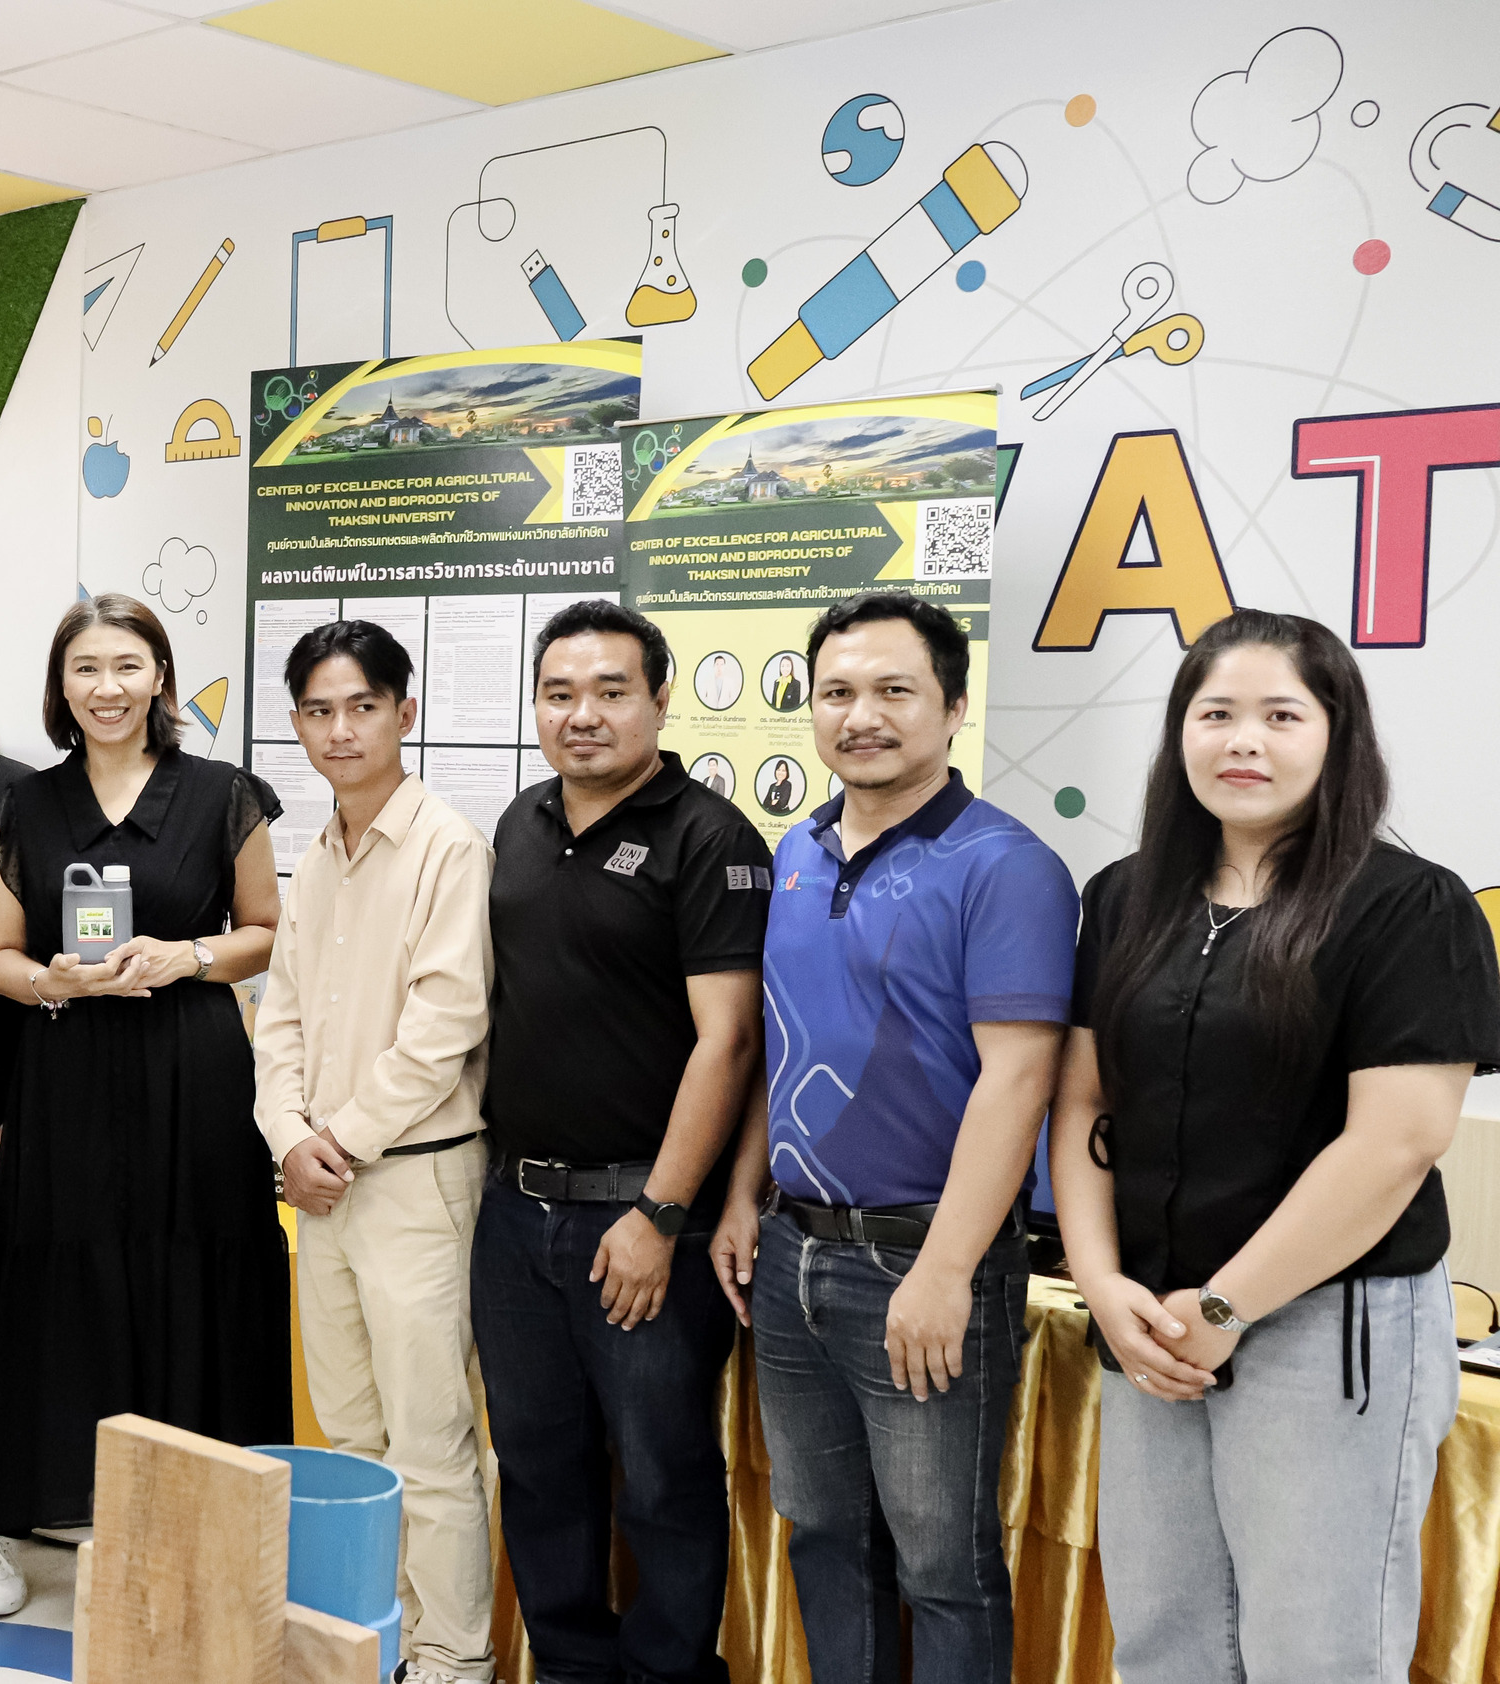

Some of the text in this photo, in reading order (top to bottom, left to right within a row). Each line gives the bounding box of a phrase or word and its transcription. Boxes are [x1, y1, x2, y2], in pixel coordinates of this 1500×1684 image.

[257, 471, 535, 497] CENTER OF EXCELLENCE FOR AGRICULTURAL
[286, 490, 501, 512] INNOVATION AND BIOPRODUCTS OF
[328, 511, 456, 527] THAKSIN UNIVERSITY
[994, 402, 1500, 652] AT
[267, 525, 609, 553] ศูนย์ความเป็นเลิศนวัตกรรมเกษตรและผลิตภัณฑ์ชีวภาพแห่งมหาวิทยาลัยทักษิณ
[630, 526, 887, 551] CENTER OF EXCELLENCE FOR AGRICULTURAL
[648, 546, 854, 566] INNOVATION AND BIOPRODUCTS OF
[261, 556, 615, 584] ผลงานตีพิมพ์ในวารสารวิชาการระดับนานาชาติ
[687, 566, 811, 582] THAKSIN UNIVERSITY
[610, 858, 635, 870] QLO
[619, 847, 642, 860] UNI
